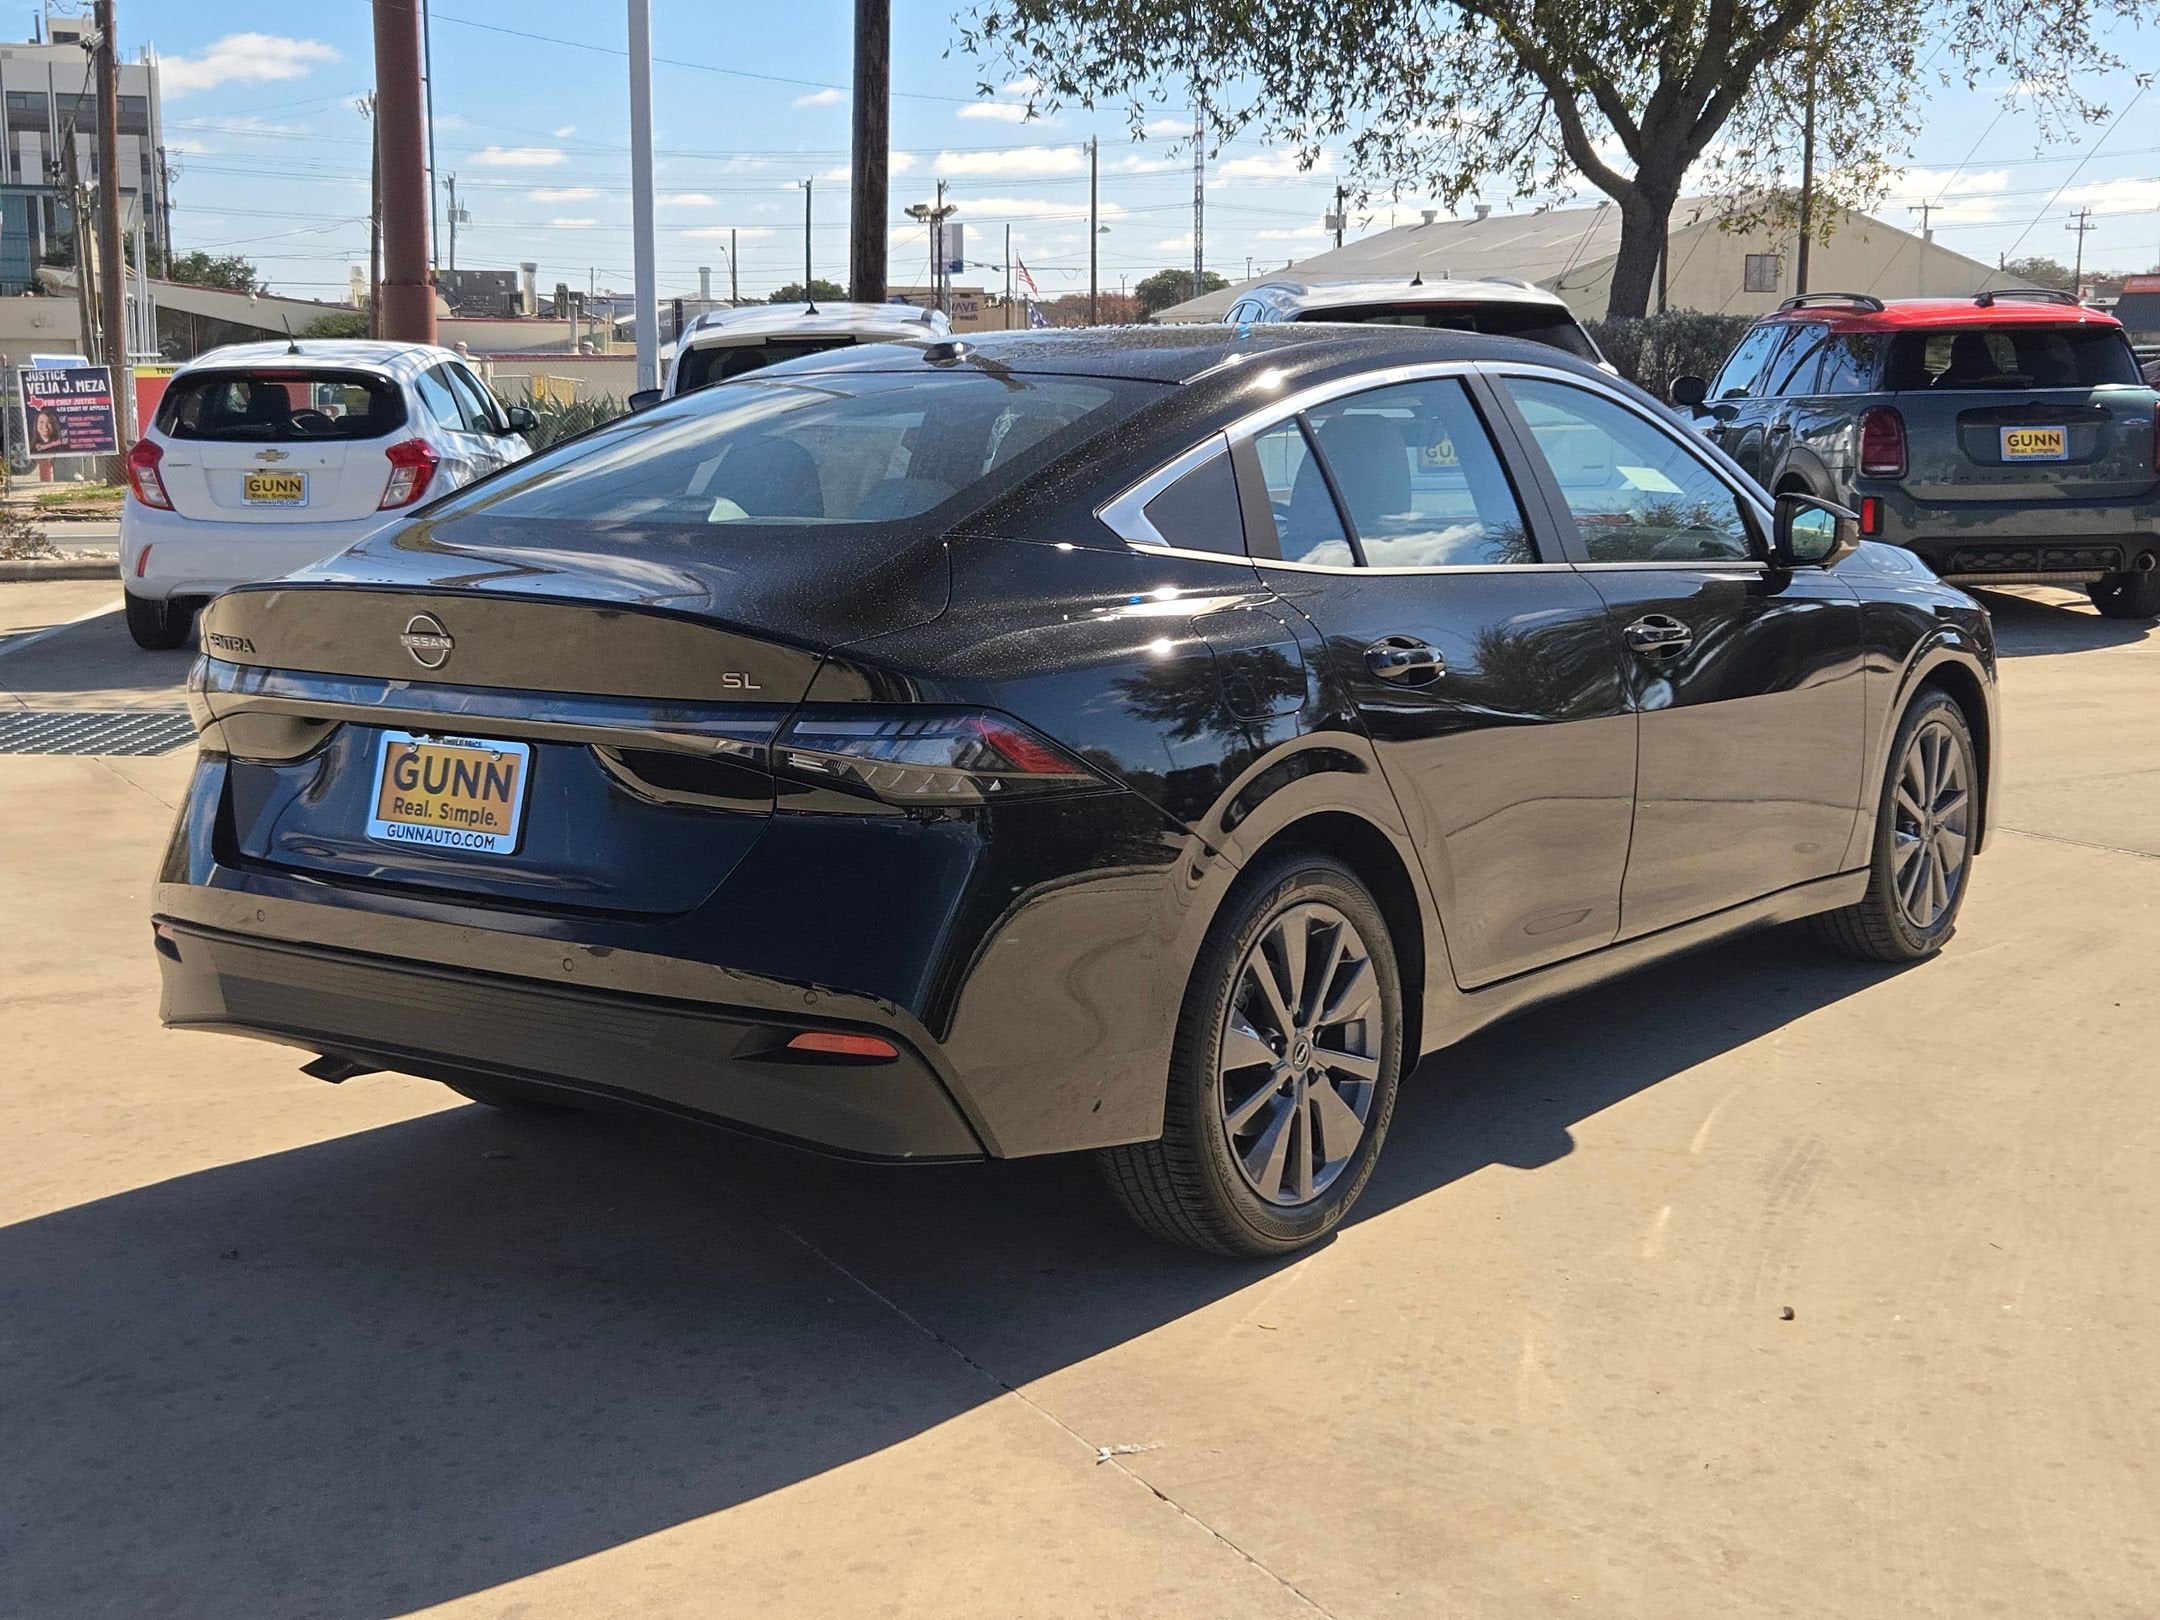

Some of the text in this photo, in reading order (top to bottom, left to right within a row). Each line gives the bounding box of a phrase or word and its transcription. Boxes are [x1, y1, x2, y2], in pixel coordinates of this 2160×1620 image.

[25, 370, 67, 382] JUSTICE
[26, 379, 107, 395] VELIA J. MEZA
[56, 398, 72, 406] CHIEF
[73, 397, 97, 405] JUSTICE
[2007, 433, 2061, 447] GUNN
[1425, 444, 1457, 459] GU
[249, 479, 302, 492] GUNN
[210, 632, 256, 653] SENTRA
[400, 633, 452, 649] NISSAN
[722, 672, 762, 690] SL
[393, 752, 515, 803] GUNN
[393, 796, 432, 818] Real.
[386, 824, 496, 850] GUNNAUTO.COM
